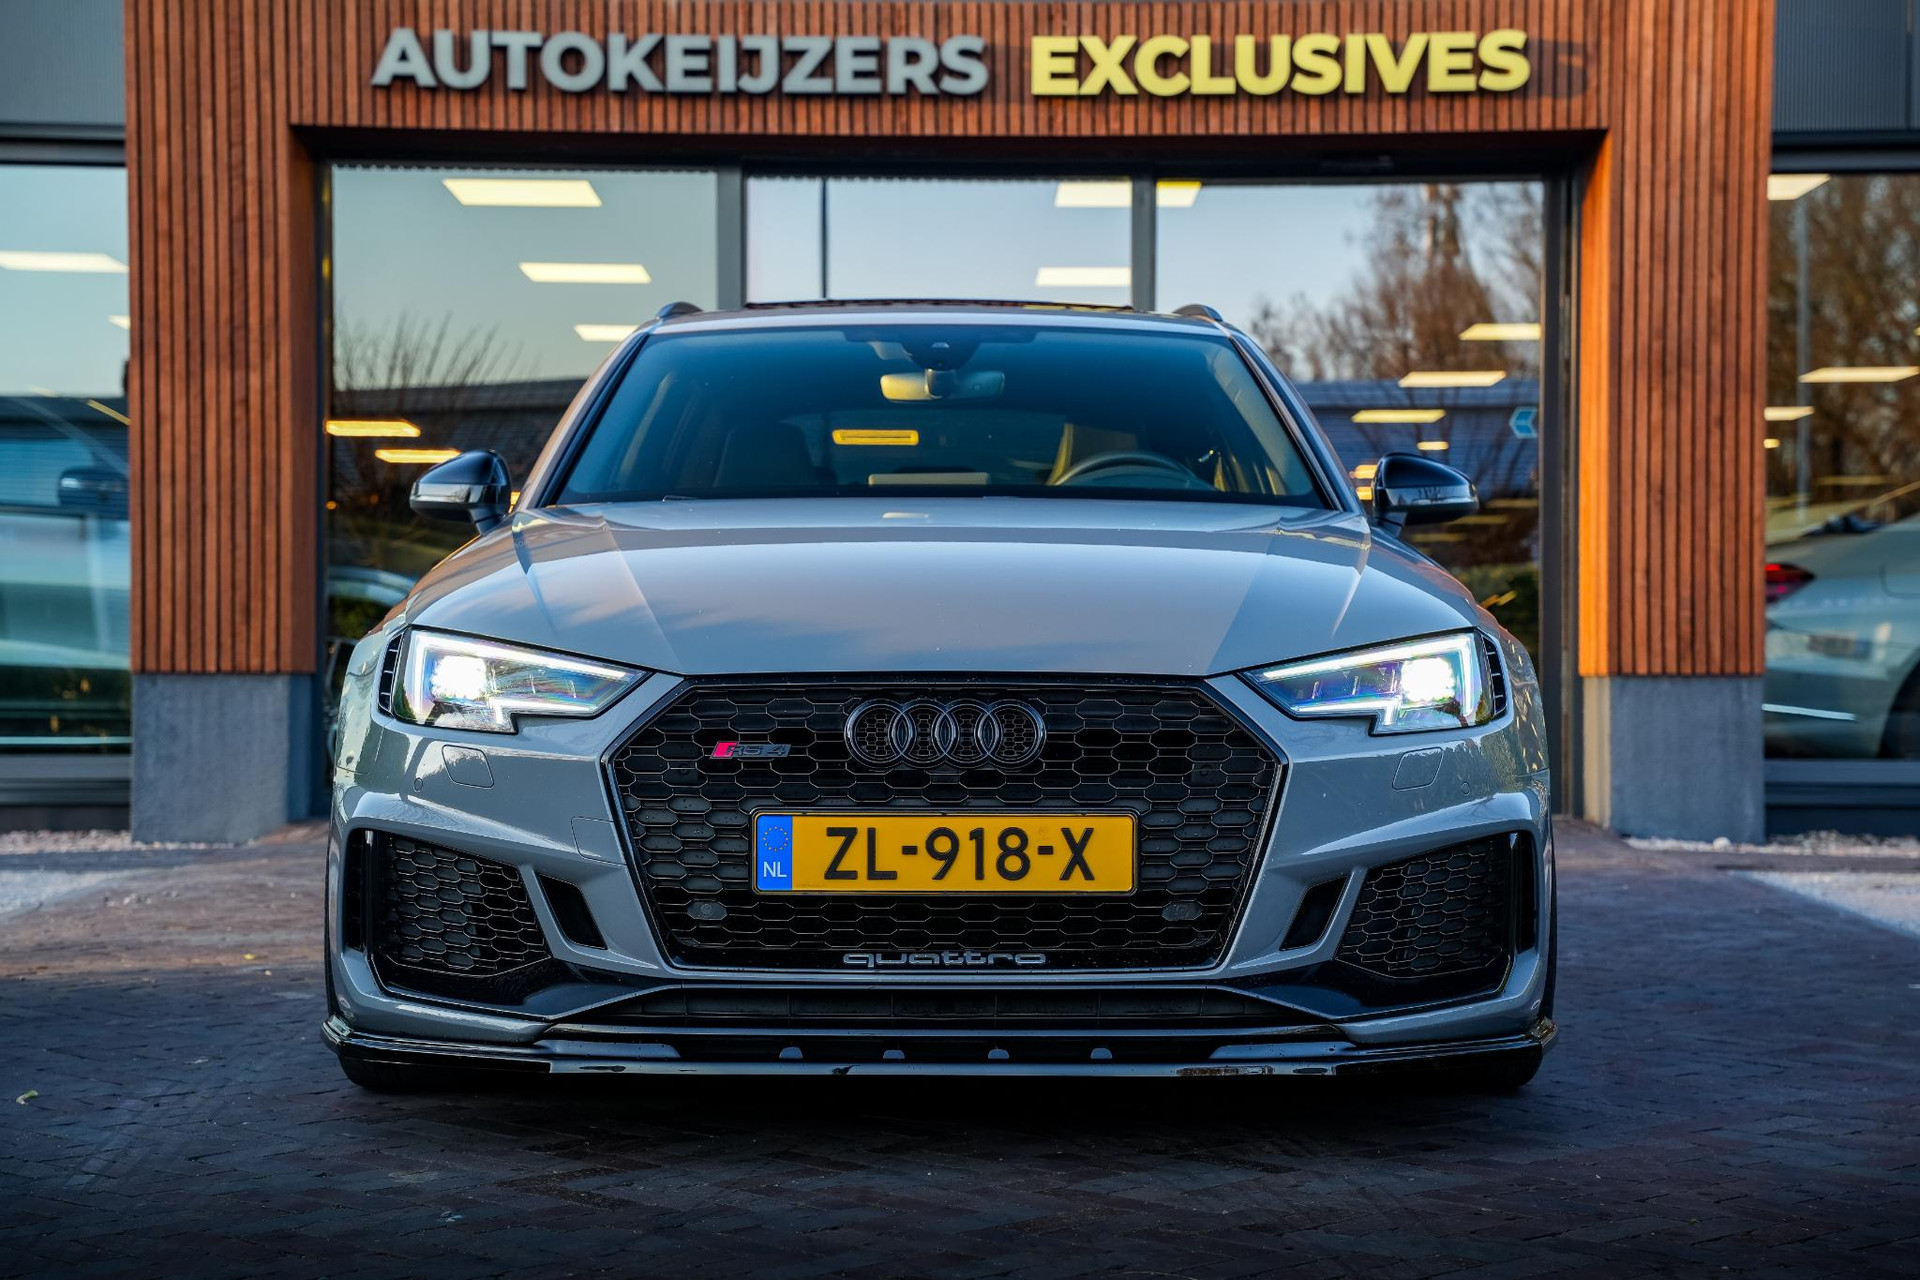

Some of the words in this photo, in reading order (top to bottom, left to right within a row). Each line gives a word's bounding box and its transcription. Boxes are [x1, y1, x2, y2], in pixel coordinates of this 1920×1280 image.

[371, 27, 989, 95] AUTOKEIJZERS
[1031, 30, 1532, 97] EXCLUSIVES
[763, 861, 787, 878] NL
[824, 827, 1095, 881] ZL-918-X
[843, 951, 1046, 967] quattro
